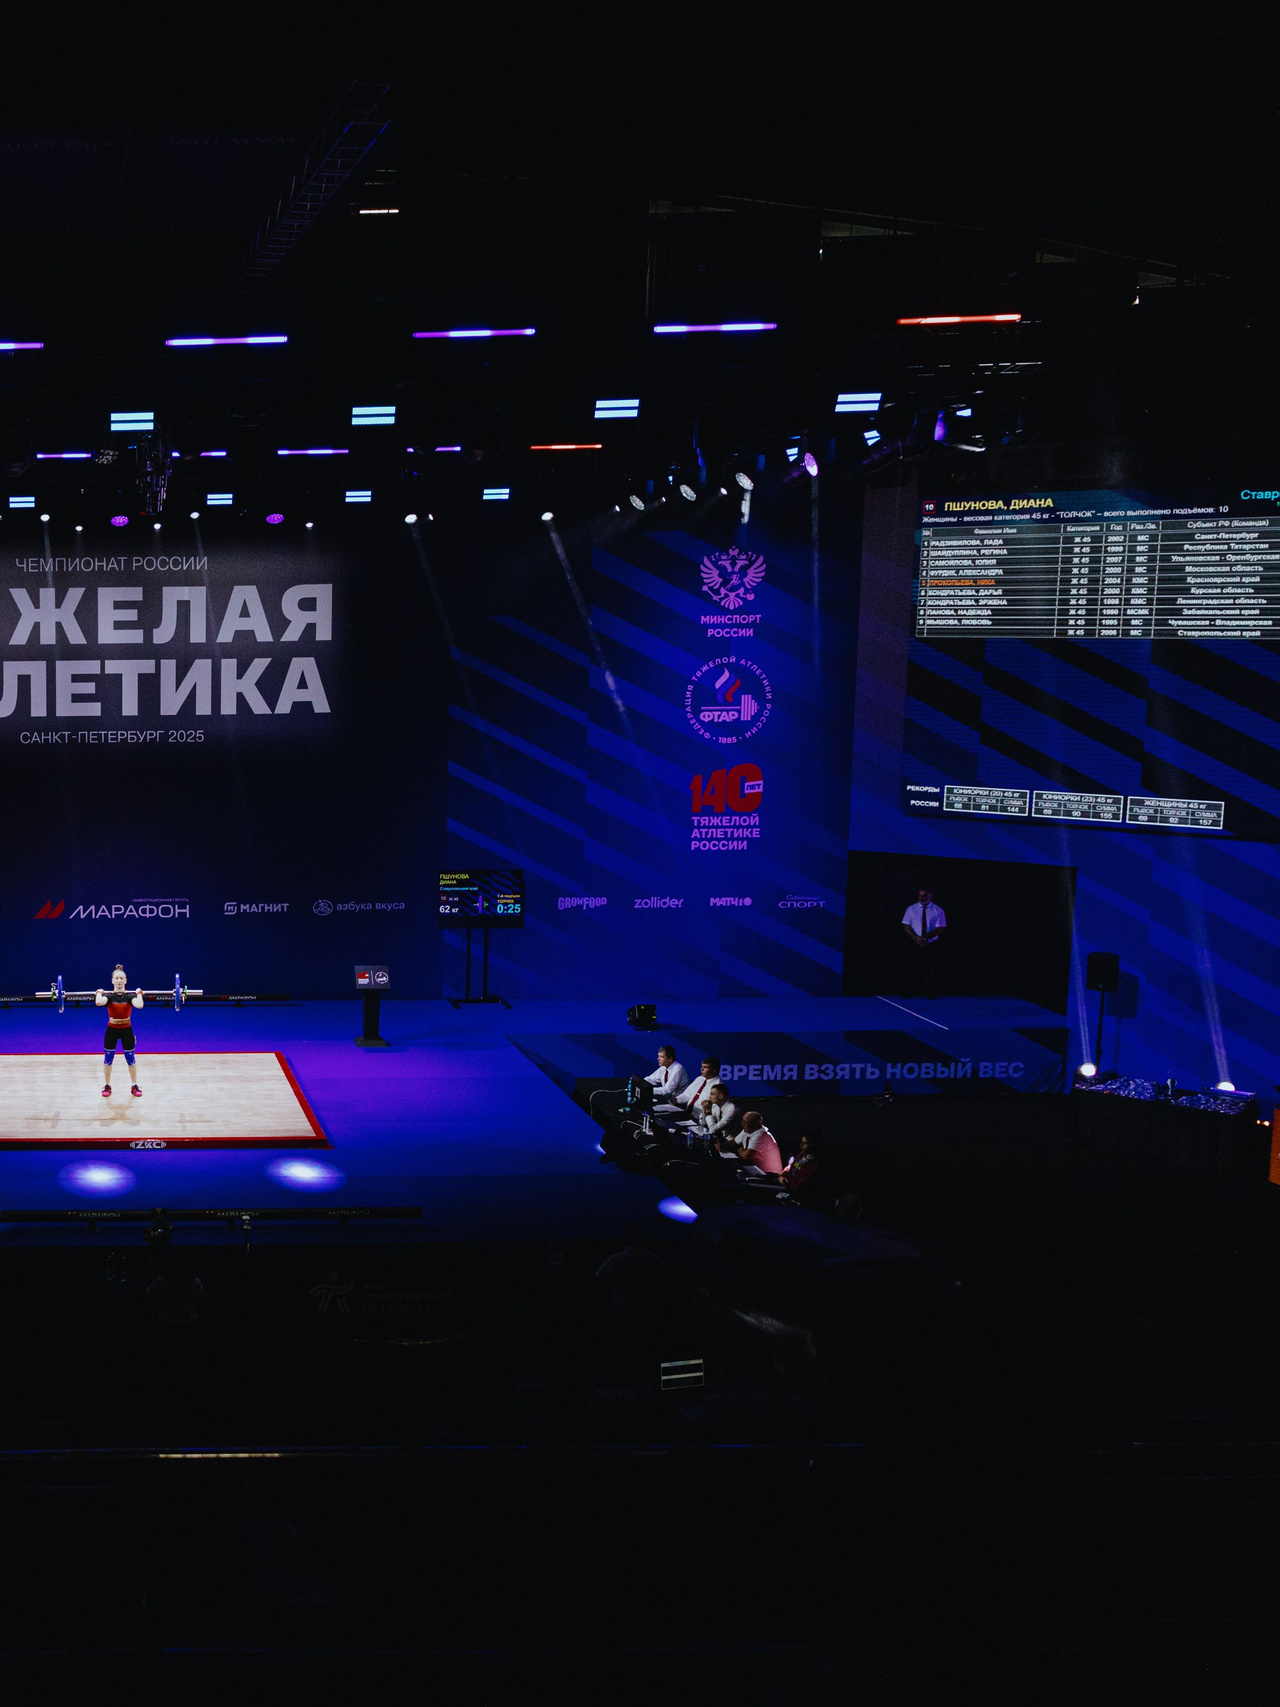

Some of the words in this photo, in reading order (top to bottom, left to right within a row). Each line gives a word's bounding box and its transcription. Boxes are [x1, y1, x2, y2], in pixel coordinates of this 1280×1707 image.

[925, 503, 934, 511] 10
[944, 501, 1007, 512] ПШУНОВА,
[1009, 498, 1053, 510] ДИАНА
[993, 514, 1030, 522] категория
[1218, 505, 1229, 513] 10
[1195, 532, 1259, 540] Санкт-Петербург
[15, 557, 127, 573] ЧЕМПИОНАТ
[132, 556, 208, 571] РОССИИ
[1242, 576, 1261, 584] край
[700, 615, 762, 624] МИНСПОРТ
[707, 628, 754, 637] РОССИИ
[691, 656, 736, 682] ТЯЖЕЛОЙ
[739, 658, 773, 699] АТЛЕТИКИ
[685, 684, 711, 739] ФЕДЕРАЦИЯ
[699, 711, 739, 722] ФТАР
[745, 703, 772, 739] РОССИИ
[20, 731, 165, 745] САНКТ-ПЕТЕРБУРГ
[168, 730, 205, 743] 2025
[718, 736, 737, 744] 1885
[689, 763, 764, 813] 140
[906, 785, 940, 793] РЕКОРДЫ
[691, 813, 760, 827] ТЯЖЕЛОЙ
[691, 828, 761, 839] АТЛЕТИКЕ
[691, 840, 748, 851] РОССИИ
[240, 903, 289, 913] МАГНИТ
[336, 902, 373, 912] азбука
[375, 901, 406, 910] вкуса
[439, 905, 450, 913] 62
[497, 904, 521, 913] 0:25
[558, 897, 607, 910] GROWFOOD
[634, 897, 684, 909] zollider
[69, 904, 190, 919] МАРАФОН
[719, 1063, 798, 1080] ВРЕМЯ
[804, 1062, 880, 1080] ВЗЯТЬ
[886, 1057, 972, 1079] НОВЫЙ
[978, 1061, 1024, 1079] ВЕС
